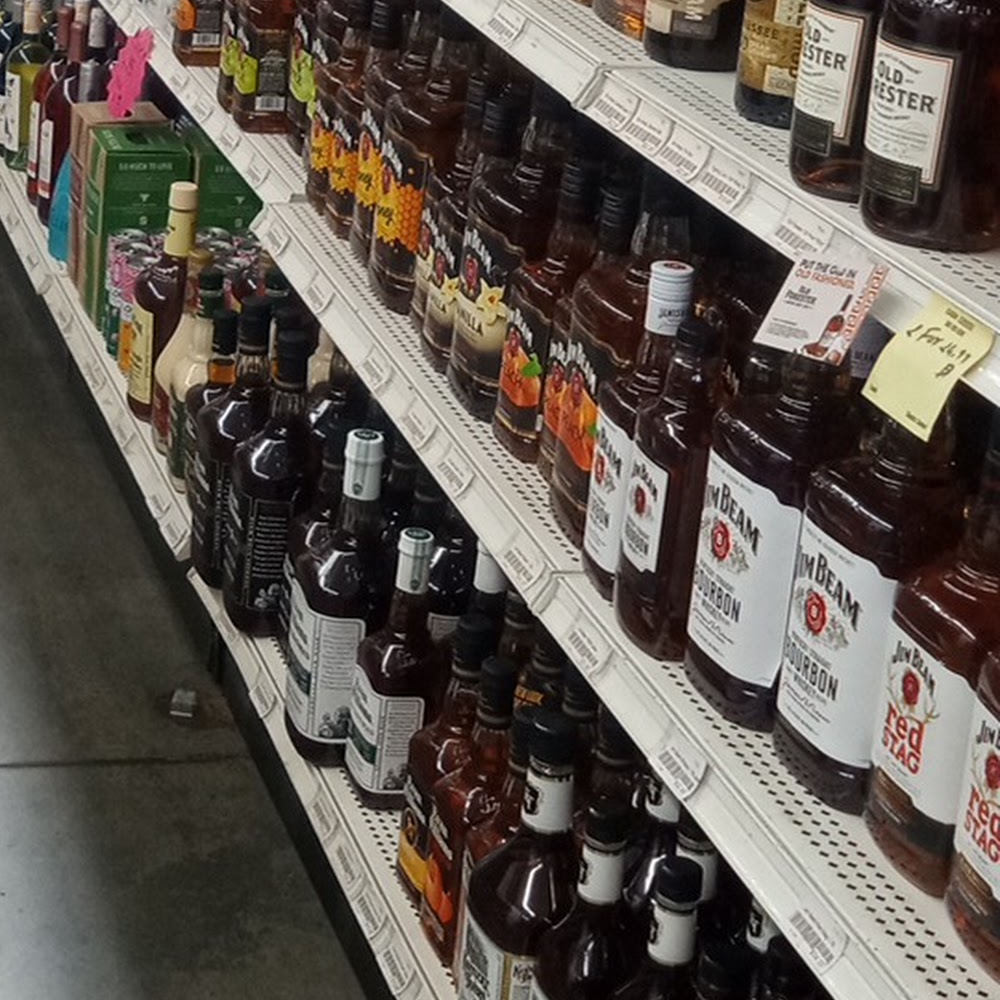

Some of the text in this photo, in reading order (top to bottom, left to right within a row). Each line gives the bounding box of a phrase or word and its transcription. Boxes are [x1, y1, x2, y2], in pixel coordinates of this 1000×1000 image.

[876, 60, 903, 85] OLD
[719, 482, 762, 557] BEAM
[815, 551, 864, 633] BEAM
[784, 634, 839, 702] BOURBON
[892, 640, 912, 664] JIM
[881, 726, 921, 775] STAG
[886, 702, 926, 754] red
